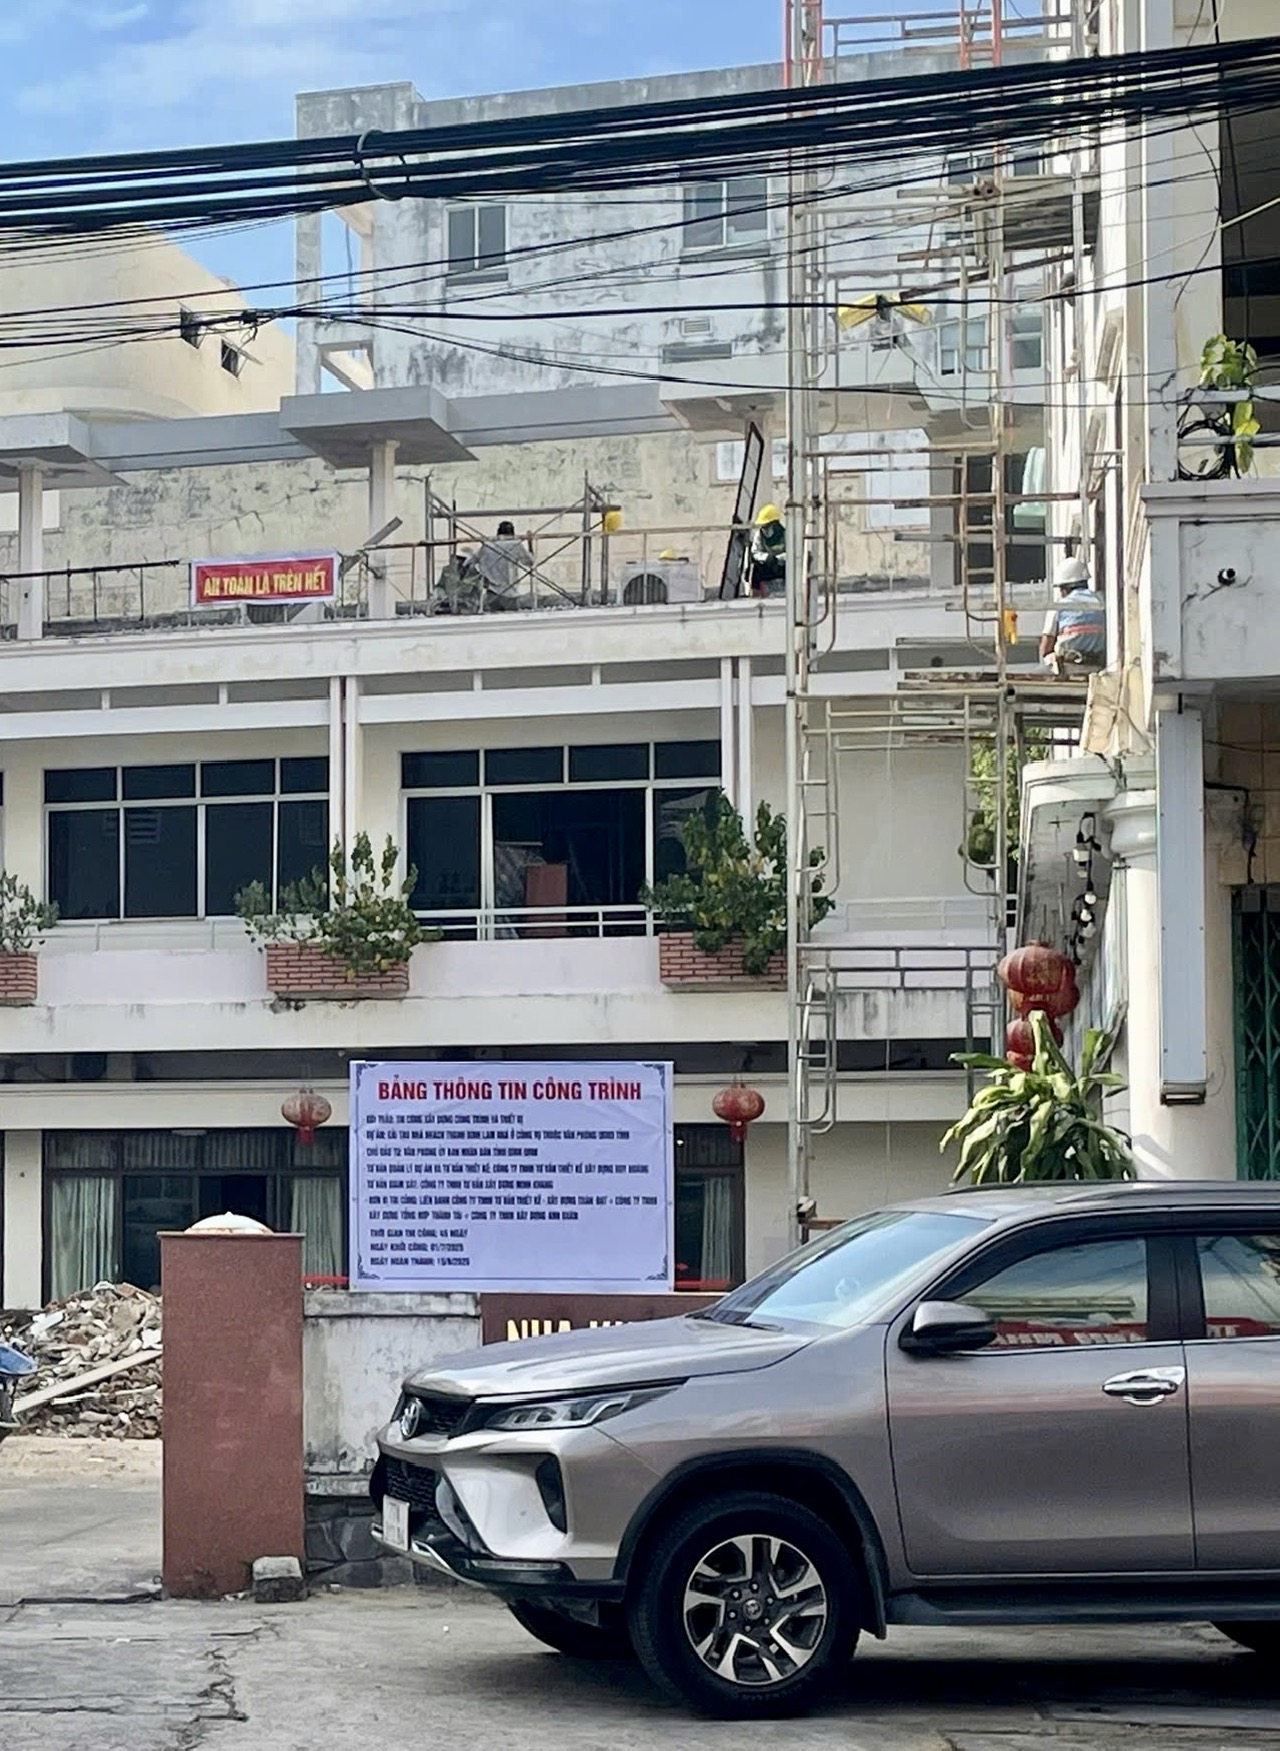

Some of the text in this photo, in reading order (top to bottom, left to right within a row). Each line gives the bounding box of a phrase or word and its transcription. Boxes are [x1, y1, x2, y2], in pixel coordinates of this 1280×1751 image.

[304, 564, 326, 592] HẾT
[378, 1075, 642, 1100] BẢNG THÔNG TIN CÔNG TRÌNH
